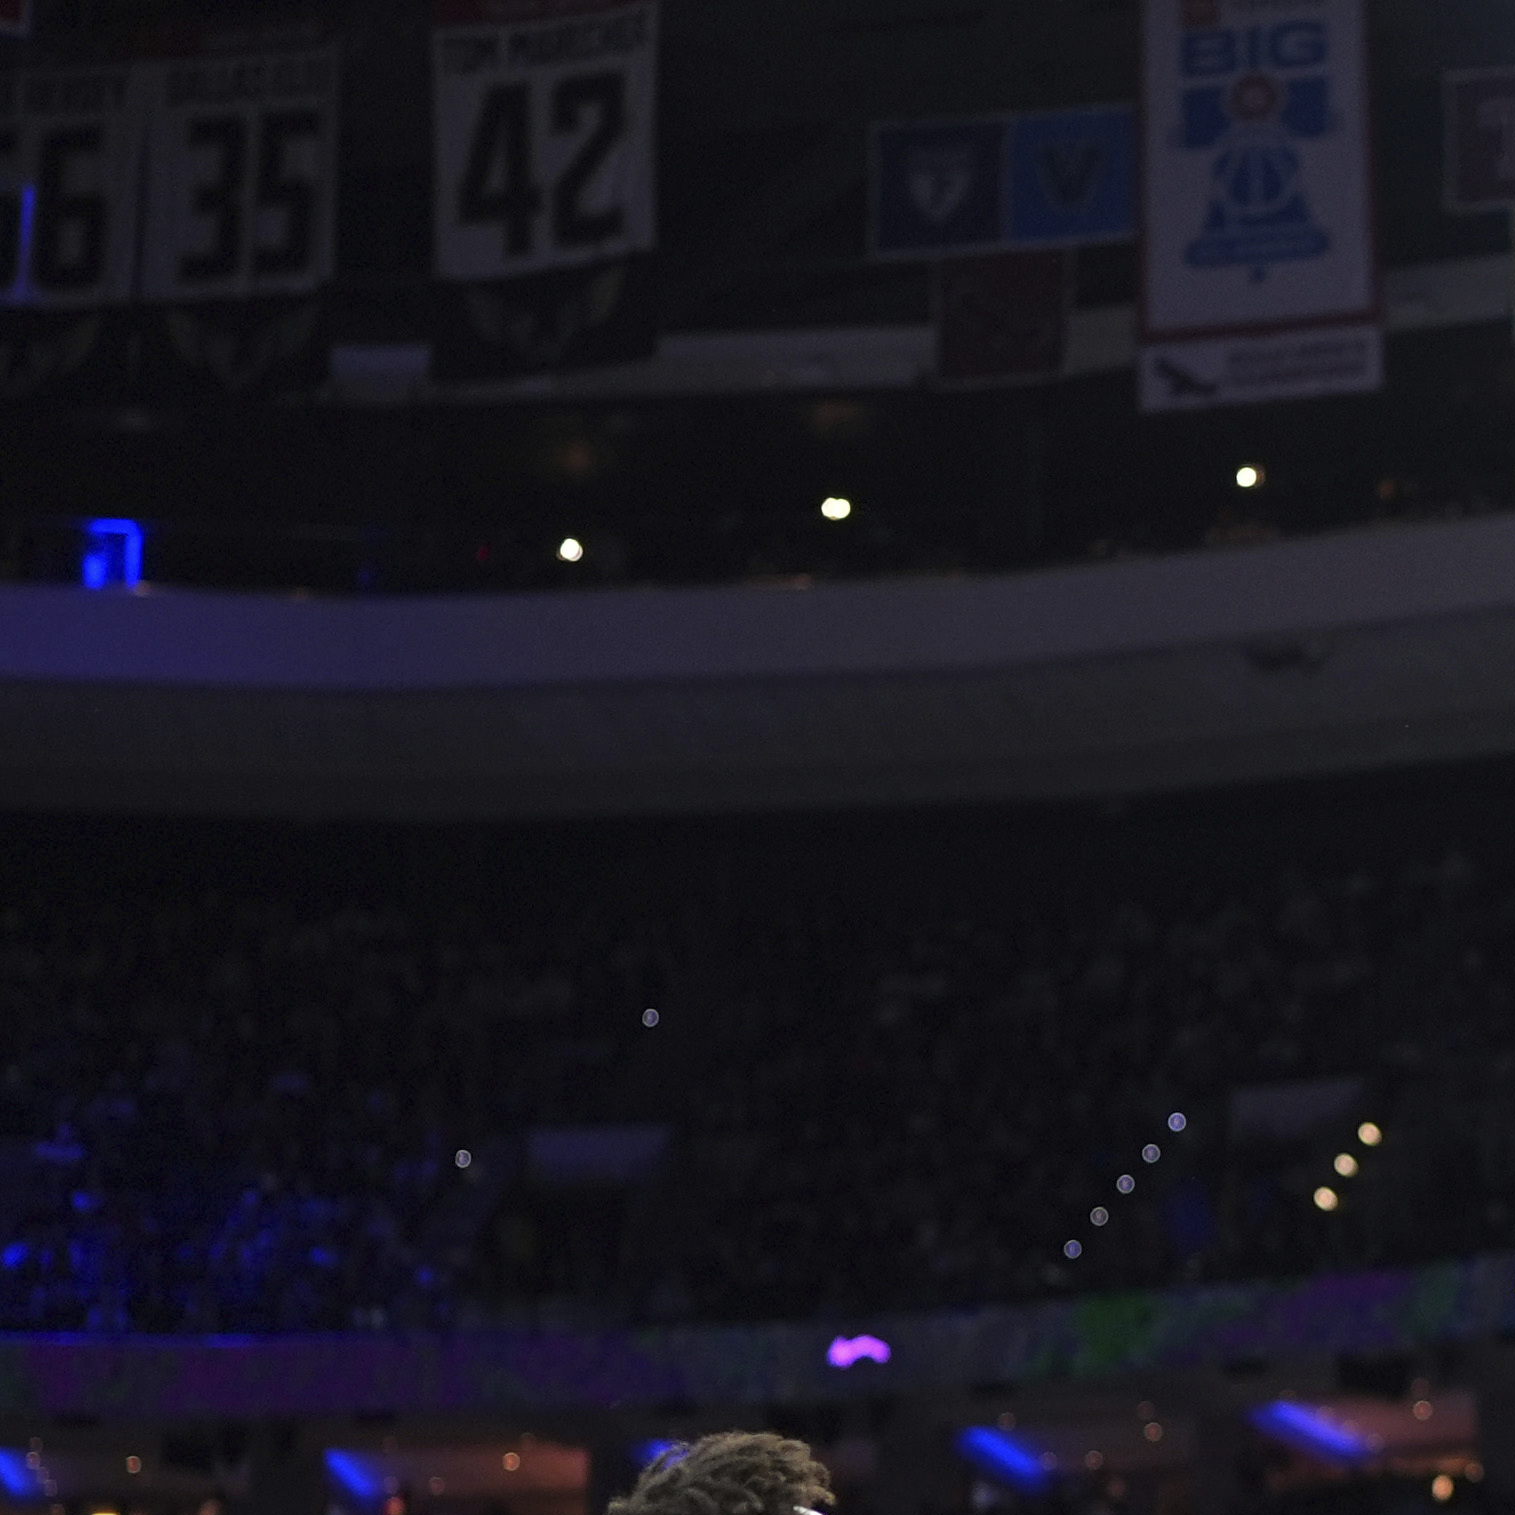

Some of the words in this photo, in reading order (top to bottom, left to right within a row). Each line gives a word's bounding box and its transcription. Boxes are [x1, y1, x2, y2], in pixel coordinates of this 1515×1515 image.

[1179, 20, 1329, 77] BIG
[178, 110, 321, 281] 35
[457, 72, 628, 259] 42
